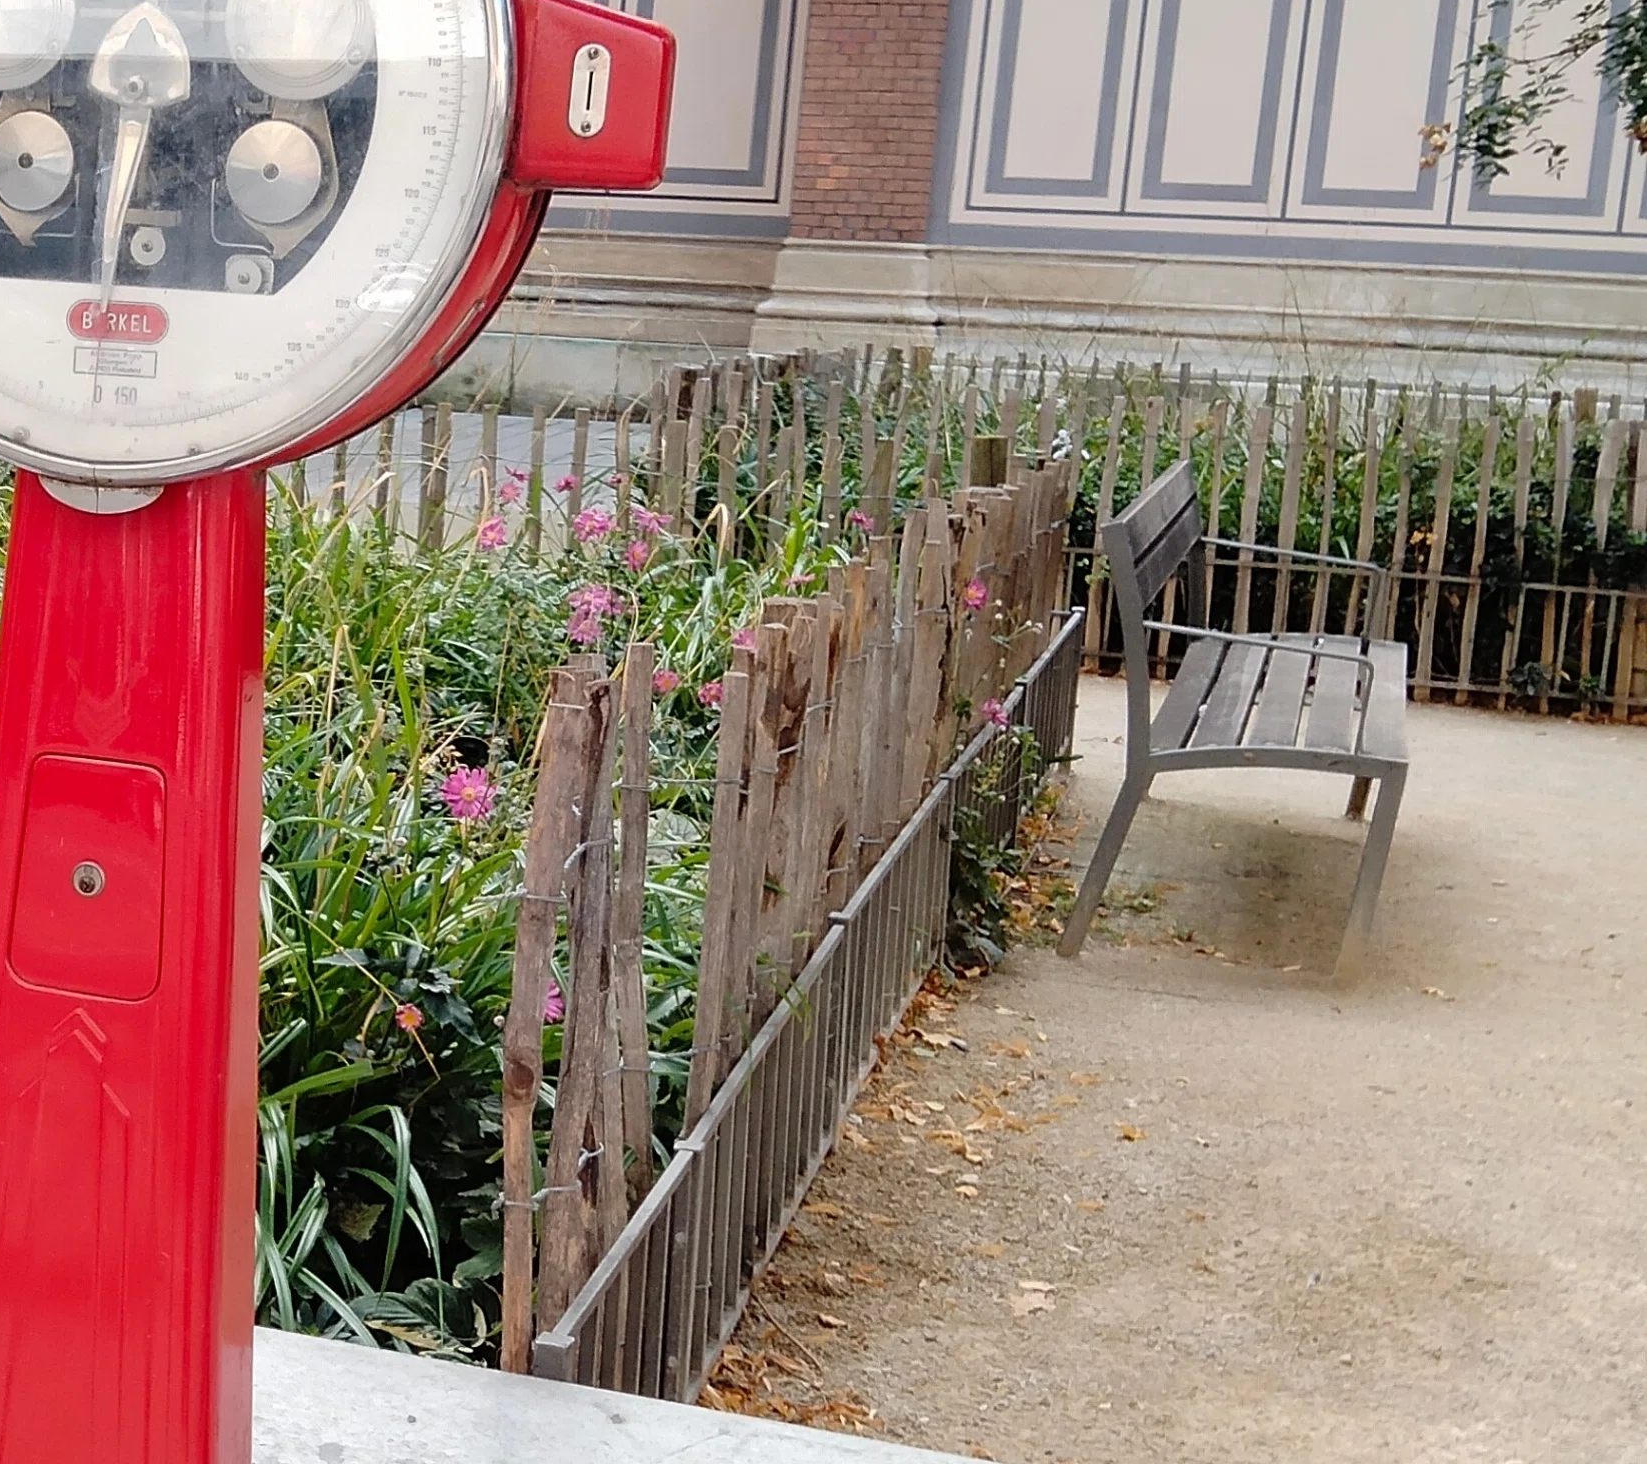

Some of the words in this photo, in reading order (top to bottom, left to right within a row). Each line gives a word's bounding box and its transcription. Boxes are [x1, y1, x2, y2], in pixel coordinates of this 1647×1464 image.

[428, 57, 442, 67] 110
[422, 125, 437, 136] 115
[82, 311, 152, 333] BRKEL
[94, 385, 102, 403] 0
[114, 386, 137, 405] 150
